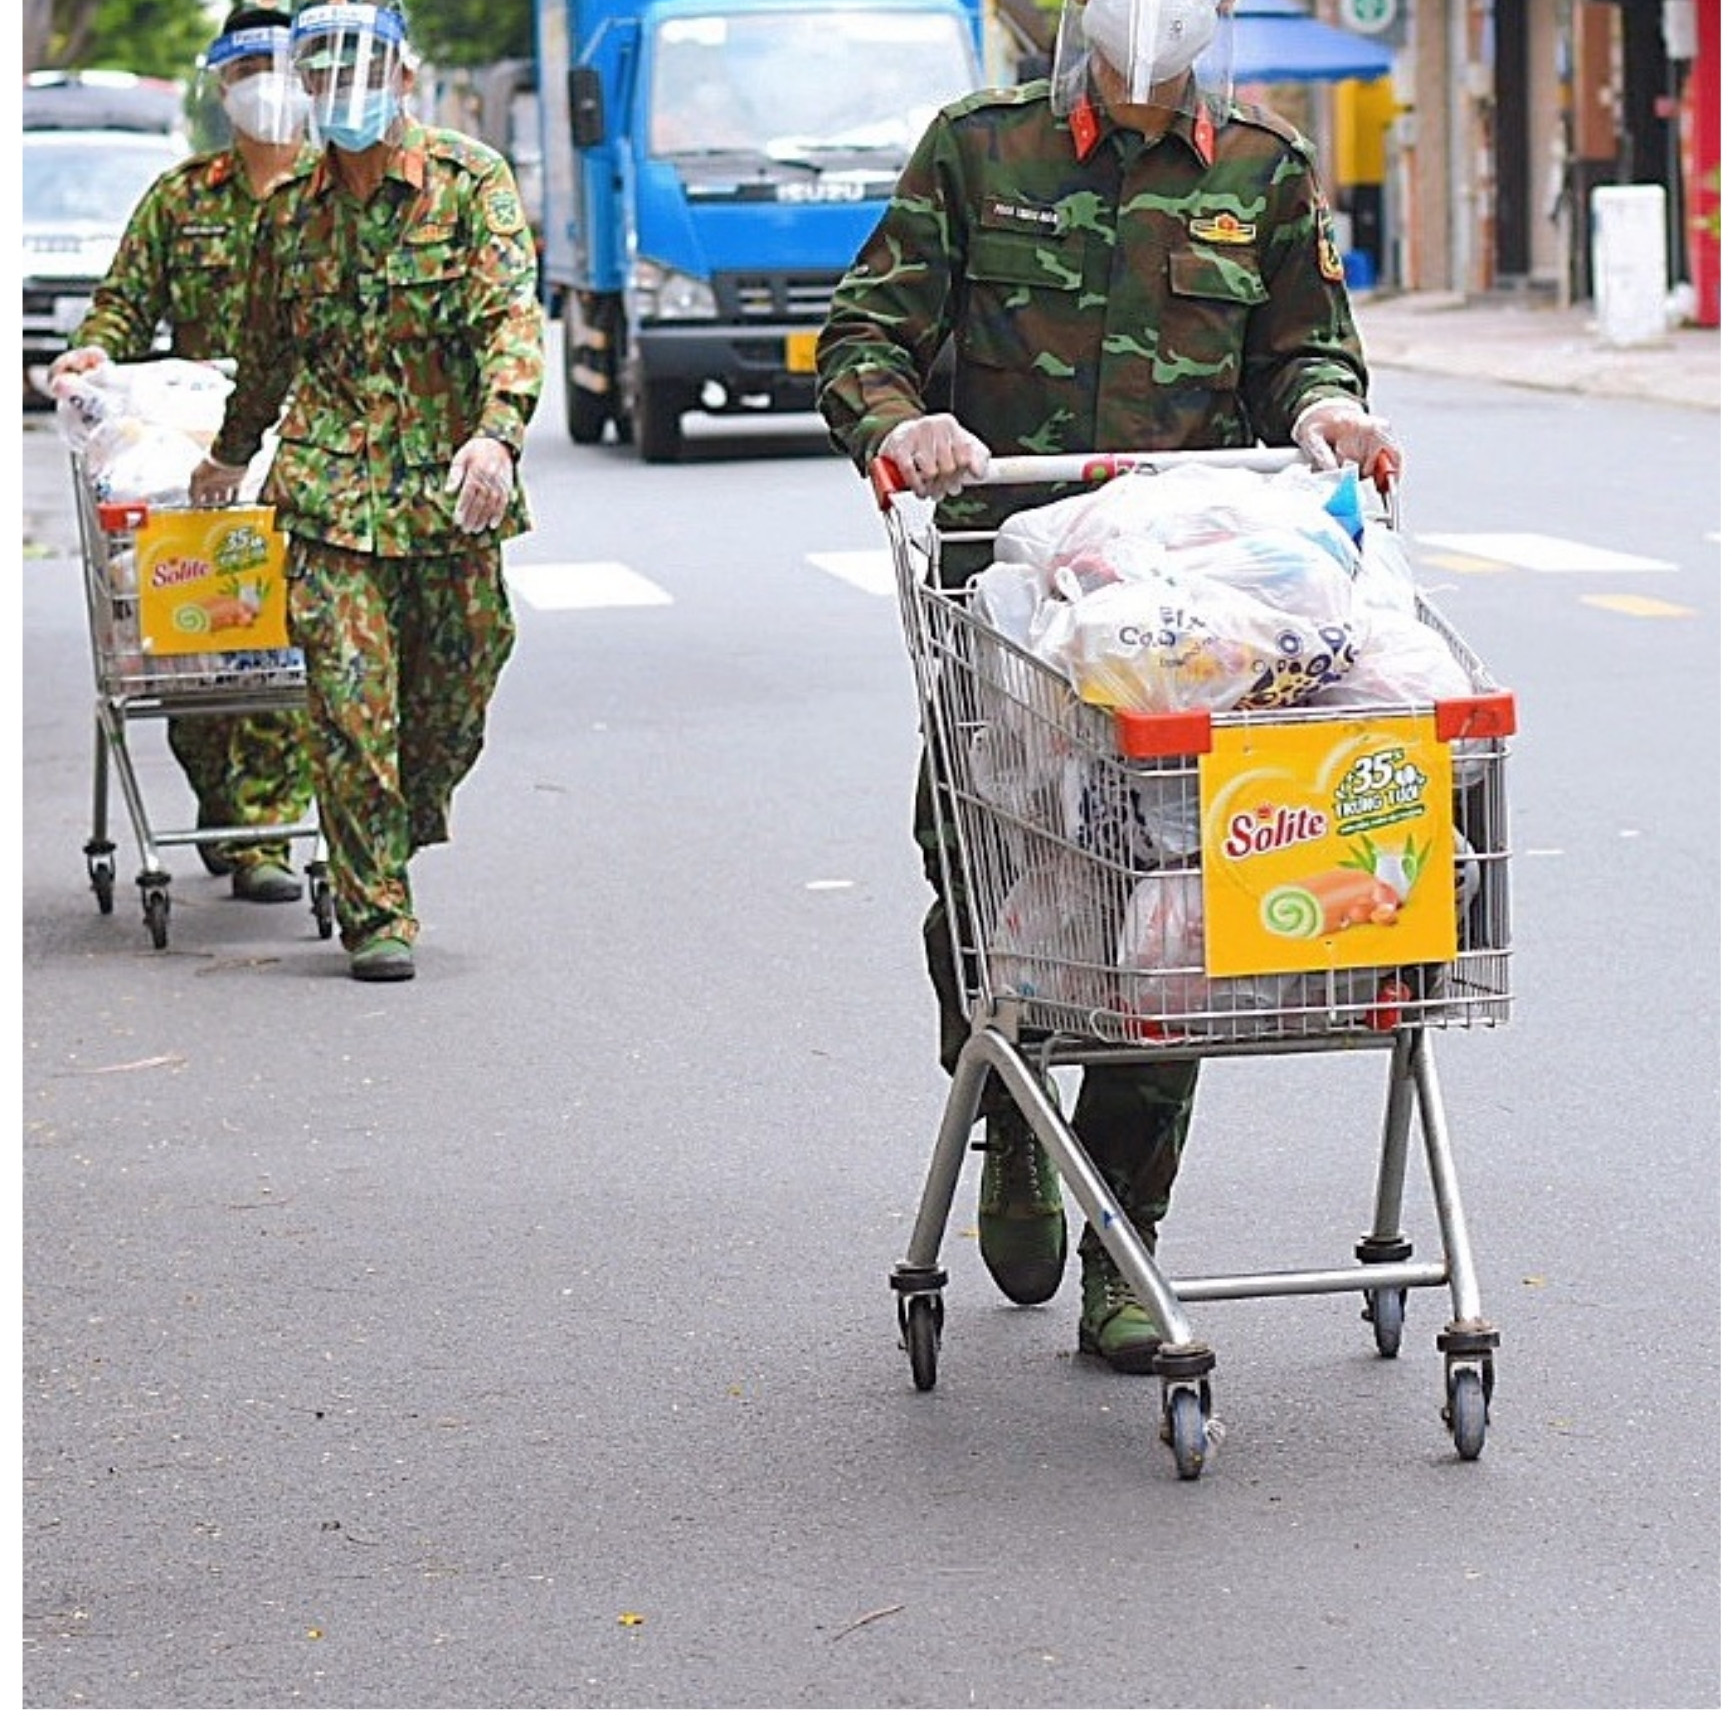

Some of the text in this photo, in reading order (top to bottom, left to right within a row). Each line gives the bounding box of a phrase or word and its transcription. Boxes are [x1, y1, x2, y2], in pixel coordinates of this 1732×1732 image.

[777, 182, 865, 202] ISUZU
[151, 559, 210, 587] Solite
[1352, 751, 1393, 795] 35
[1225, 806, 1327, 859] Solite
